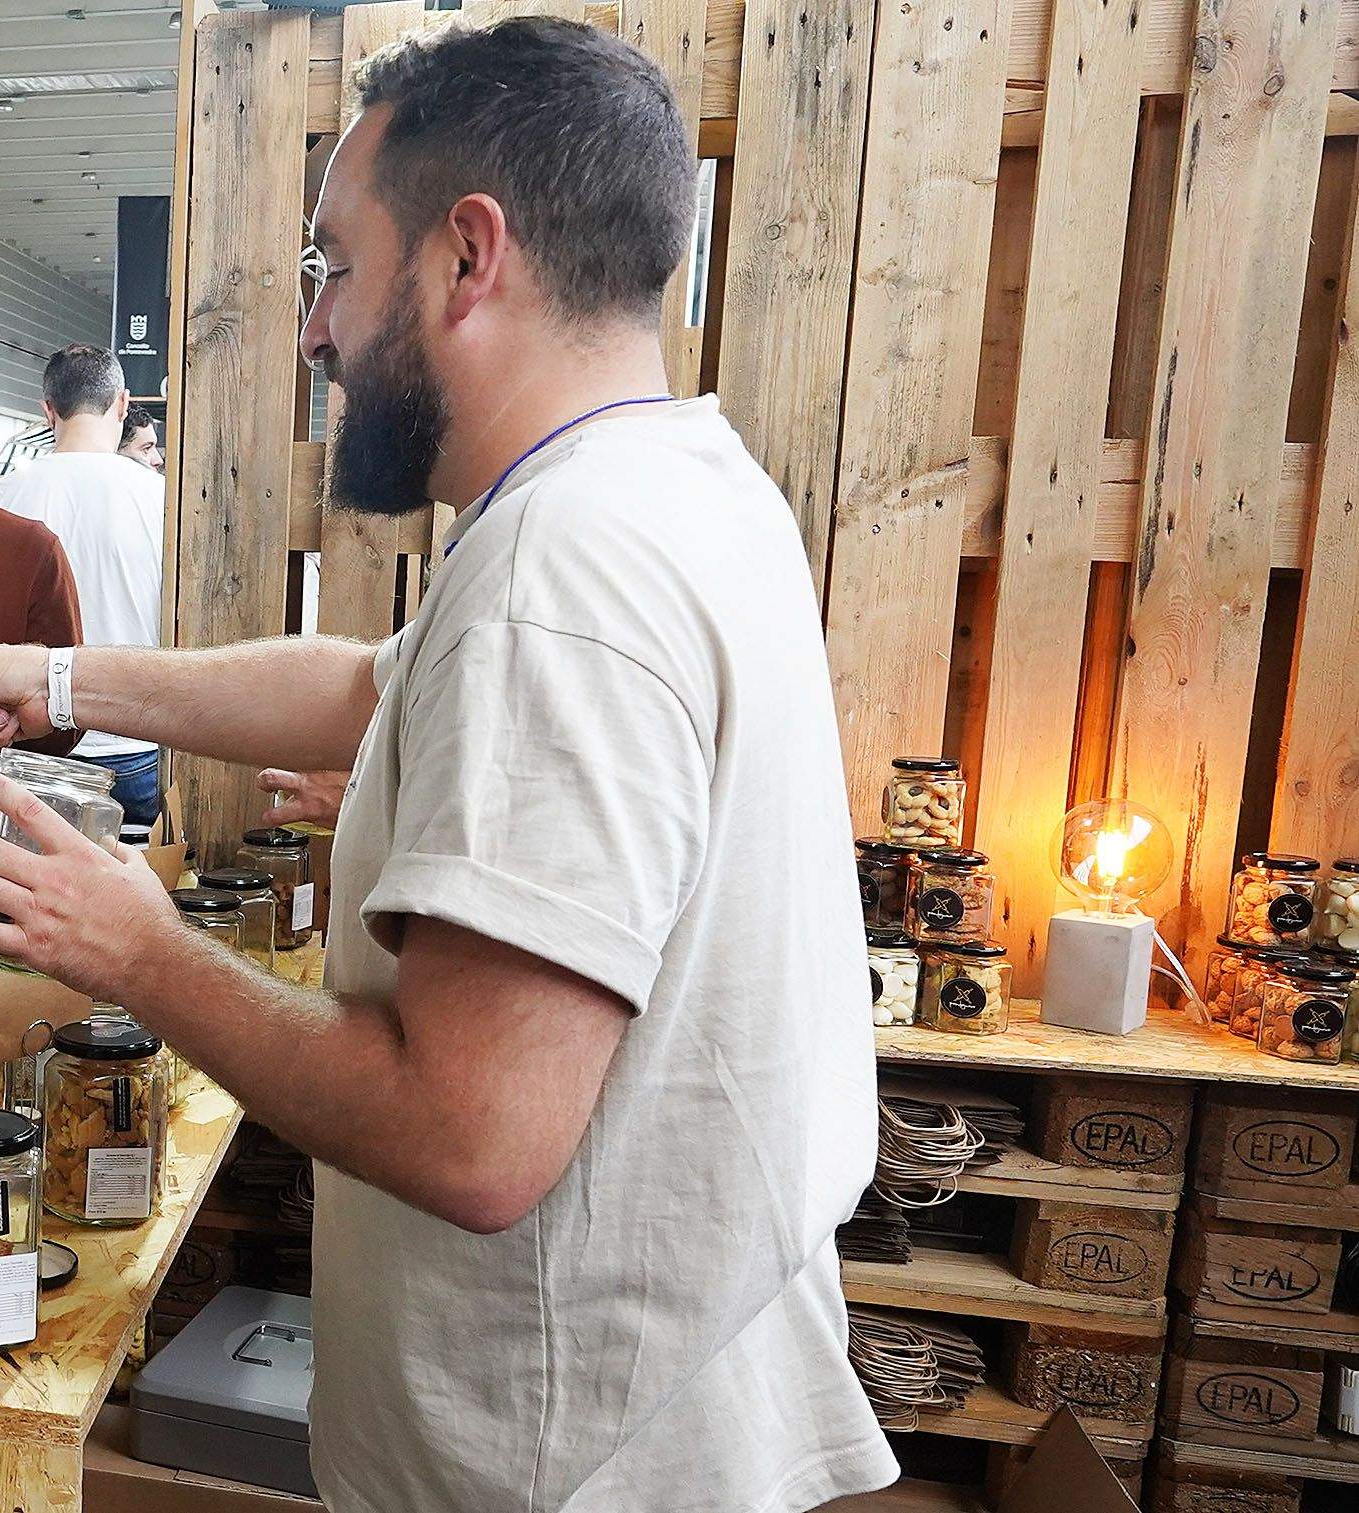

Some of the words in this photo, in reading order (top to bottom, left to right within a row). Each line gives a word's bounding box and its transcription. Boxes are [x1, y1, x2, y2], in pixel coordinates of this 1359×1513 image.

[1085, 1121, 1158, 1156] EPAL
[1249, 1131, 1323, 1166] EPAL
[1063, 1240, 1131, 1275] EPAL
[1211, 1381, 1283, 1419] EPAL
